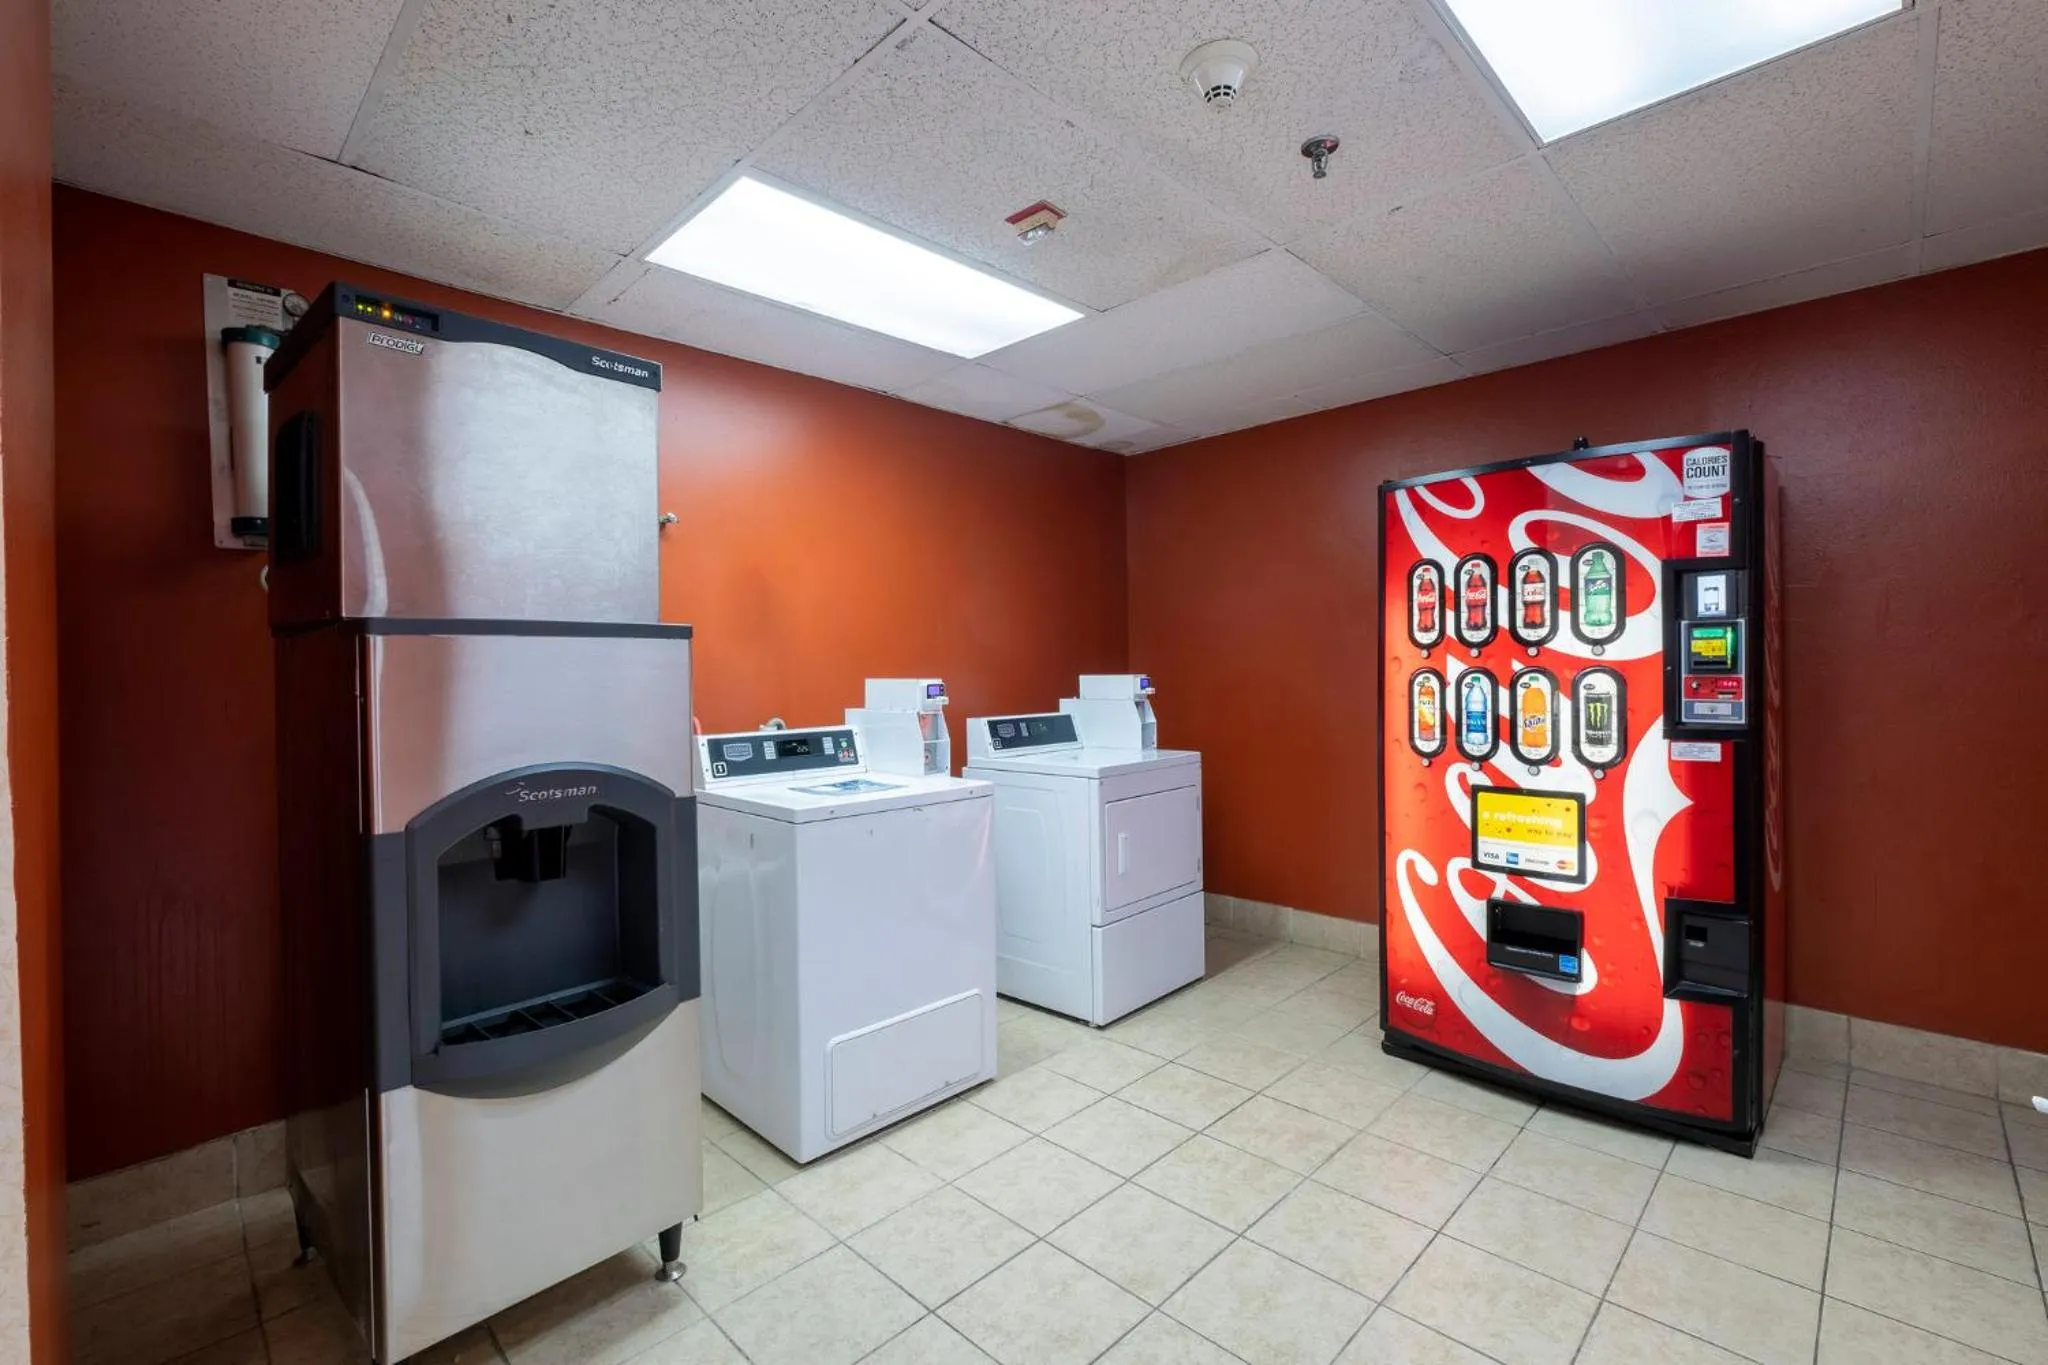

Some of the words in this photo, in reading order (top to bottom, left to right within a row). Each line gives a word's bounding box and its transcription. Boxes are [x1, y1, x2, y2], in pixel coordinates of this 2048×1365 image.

[591, 355, 649, 377] Scotsman
[1686, 455, 1728, 467] CALORIES
[1686, 465, 1726, 479] COUNT
[518, 785, 598, 802] Scotsman
[1494, 811, 1563, 830] refreshing
[1483, 852, 1500, 860] VISA
